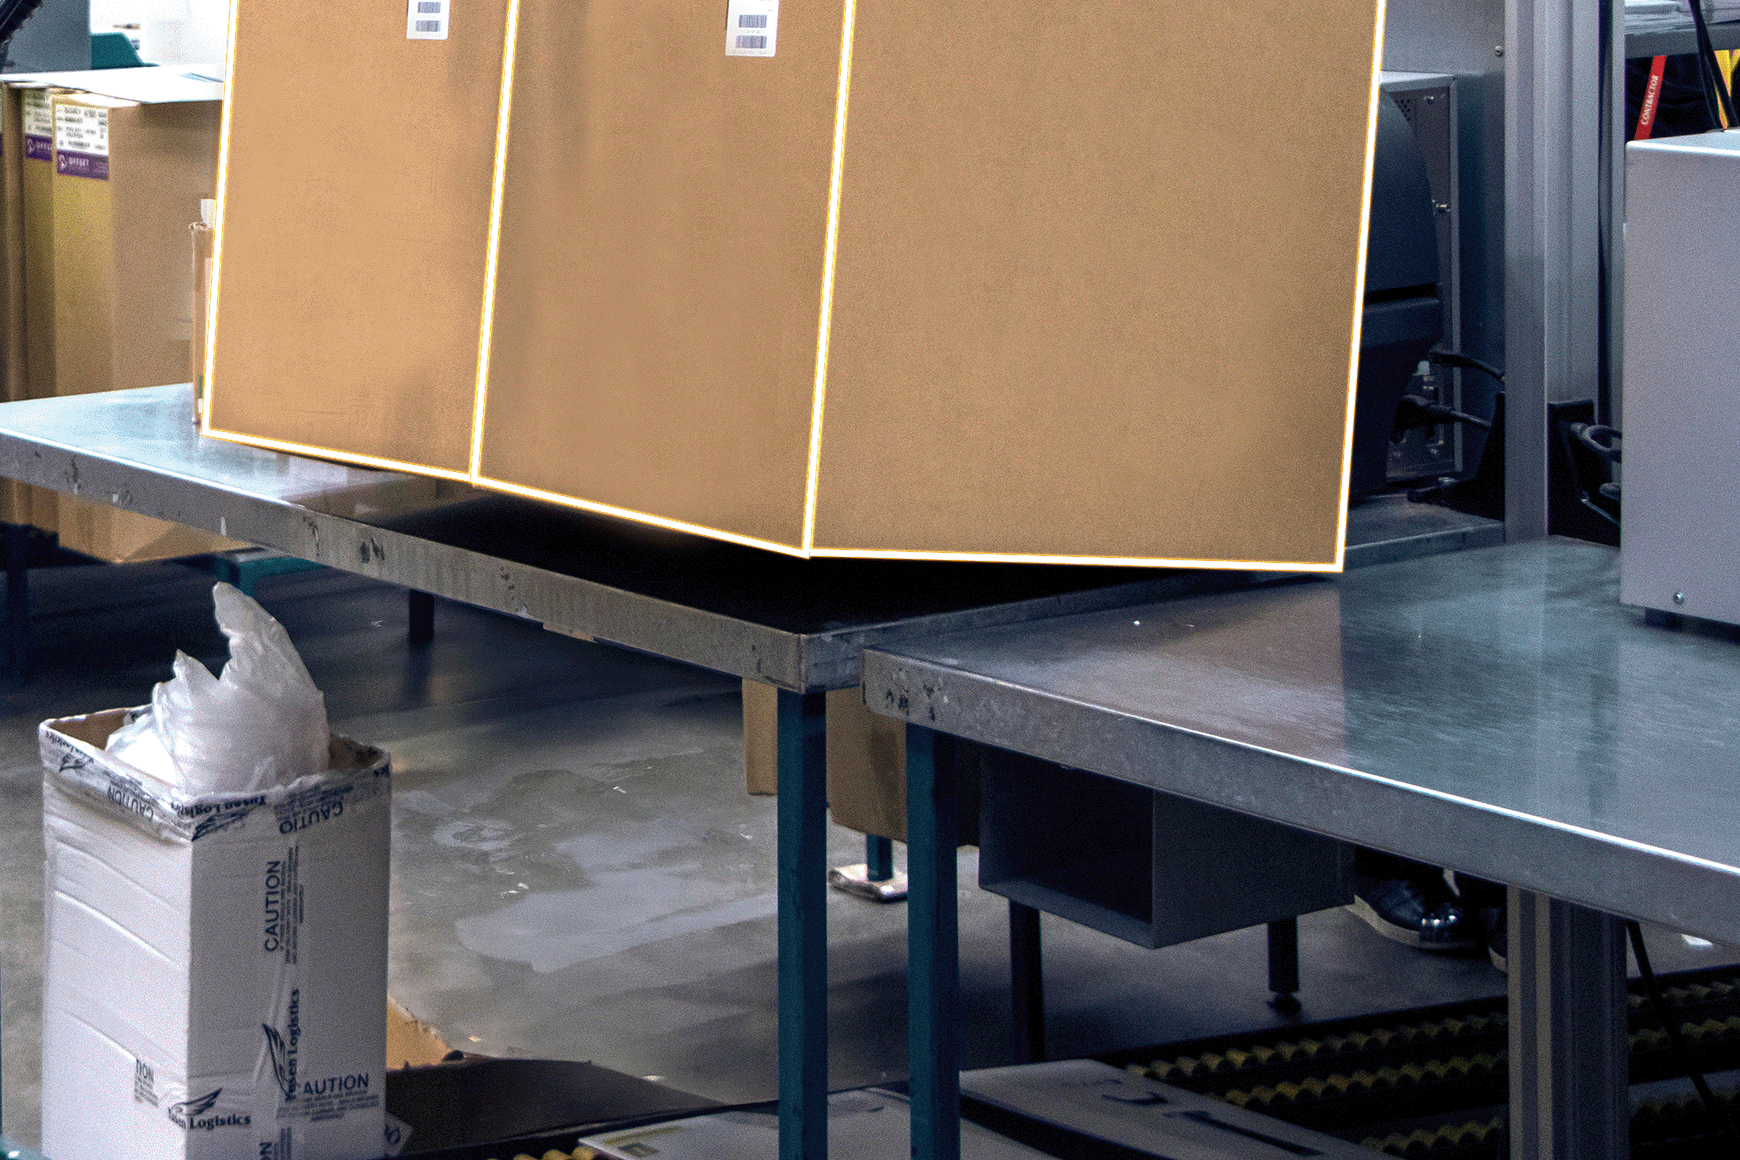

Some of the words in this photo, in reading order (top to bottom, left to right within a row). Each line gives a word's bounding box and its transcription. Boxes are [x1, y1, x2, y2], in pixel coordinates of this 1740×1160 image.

[1640, 74, 1659, 126] CONTRACTOR
[224, 794, 267, 810] Yusen
[264, 860, 280, 952] CAUTION
[288, 988, 301, 1055] Logistics
[285, 1059, 297, 1102] Yusen
[303, 1072, 369, 1095] AUTION
[189, 1113, 252, 1131] Logistics
